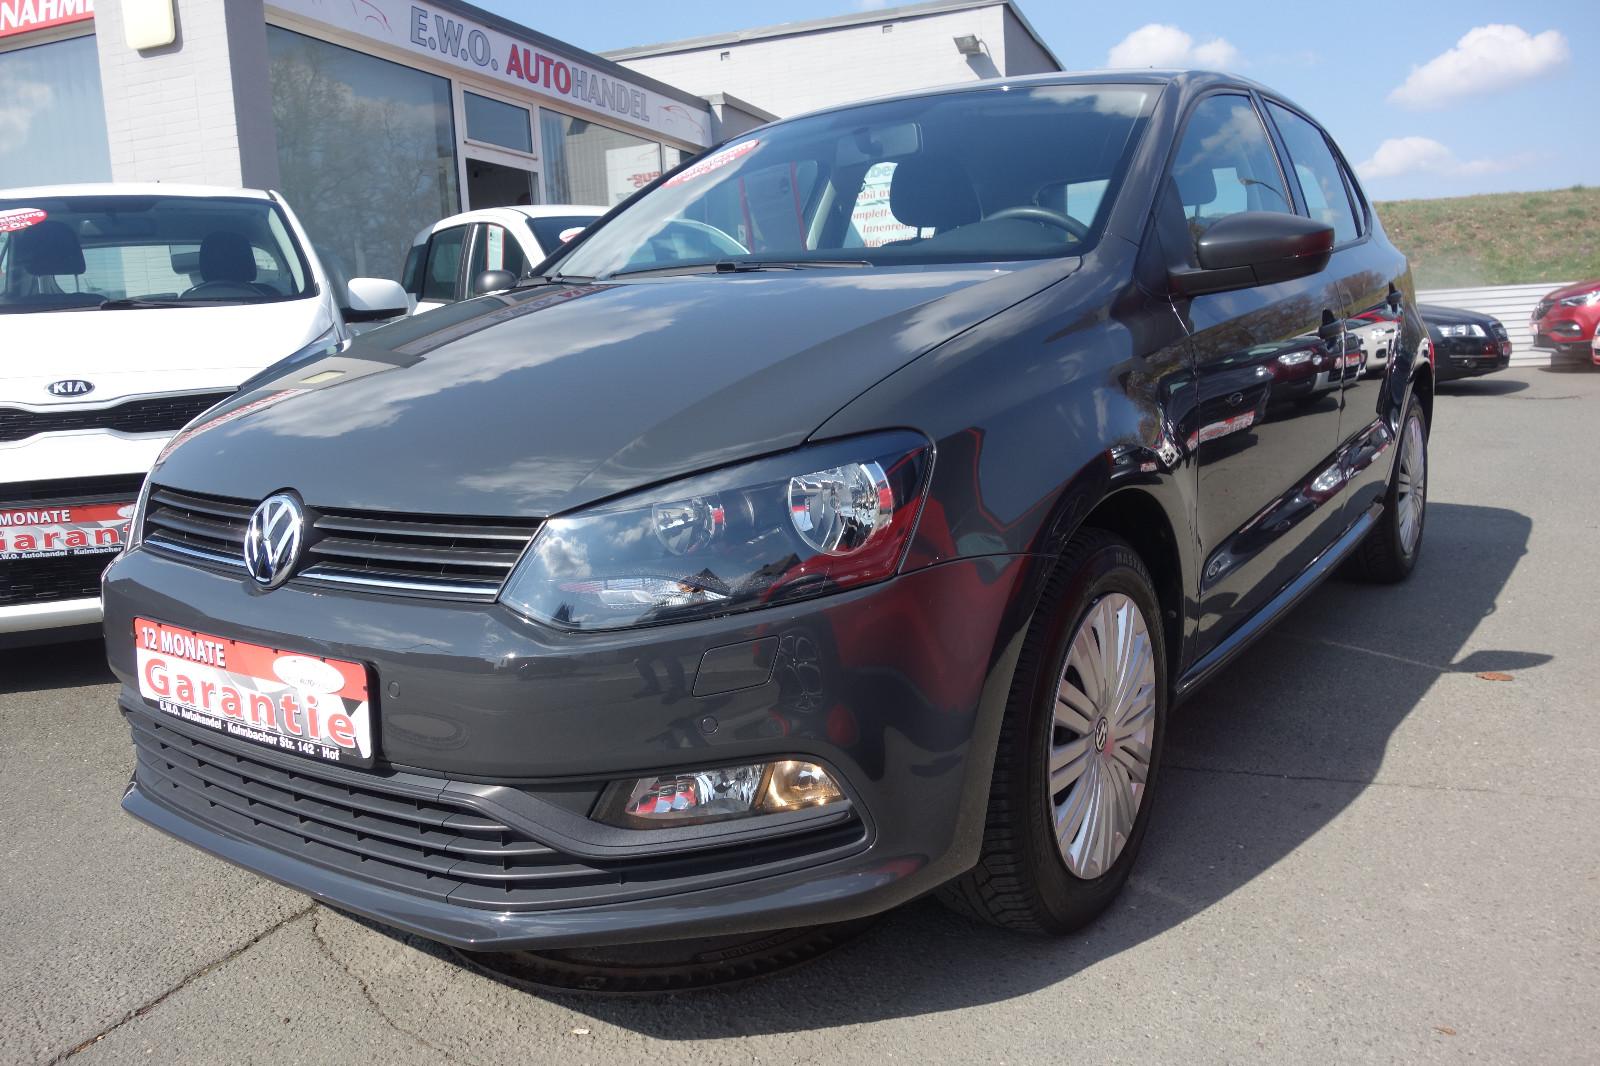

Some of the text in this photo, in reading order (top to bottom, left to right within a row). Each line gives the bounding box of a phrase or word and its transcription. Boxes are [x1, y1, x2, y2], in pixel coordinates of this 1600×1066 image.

[410, 5, 650, 122] E.W.O. AUTOHANDEL
[52, 380, 88, 394] KIA
[0, 509, 71, 526] MONATE
[0, 523, 131, 552] aran
[21, 549, 68, 559] Autohandel
[142, 626, 227, 668] 12 MONATE
[144, 657, 356, 749] Garantie
[181, 706, 222, 730] Autohandel
[227, 721, 278, 745] Kulmbacher
[279, 736, 296, 750] Str.
[298, 741, 315, 755] 142
[322, 747, 340, 761] Hof
